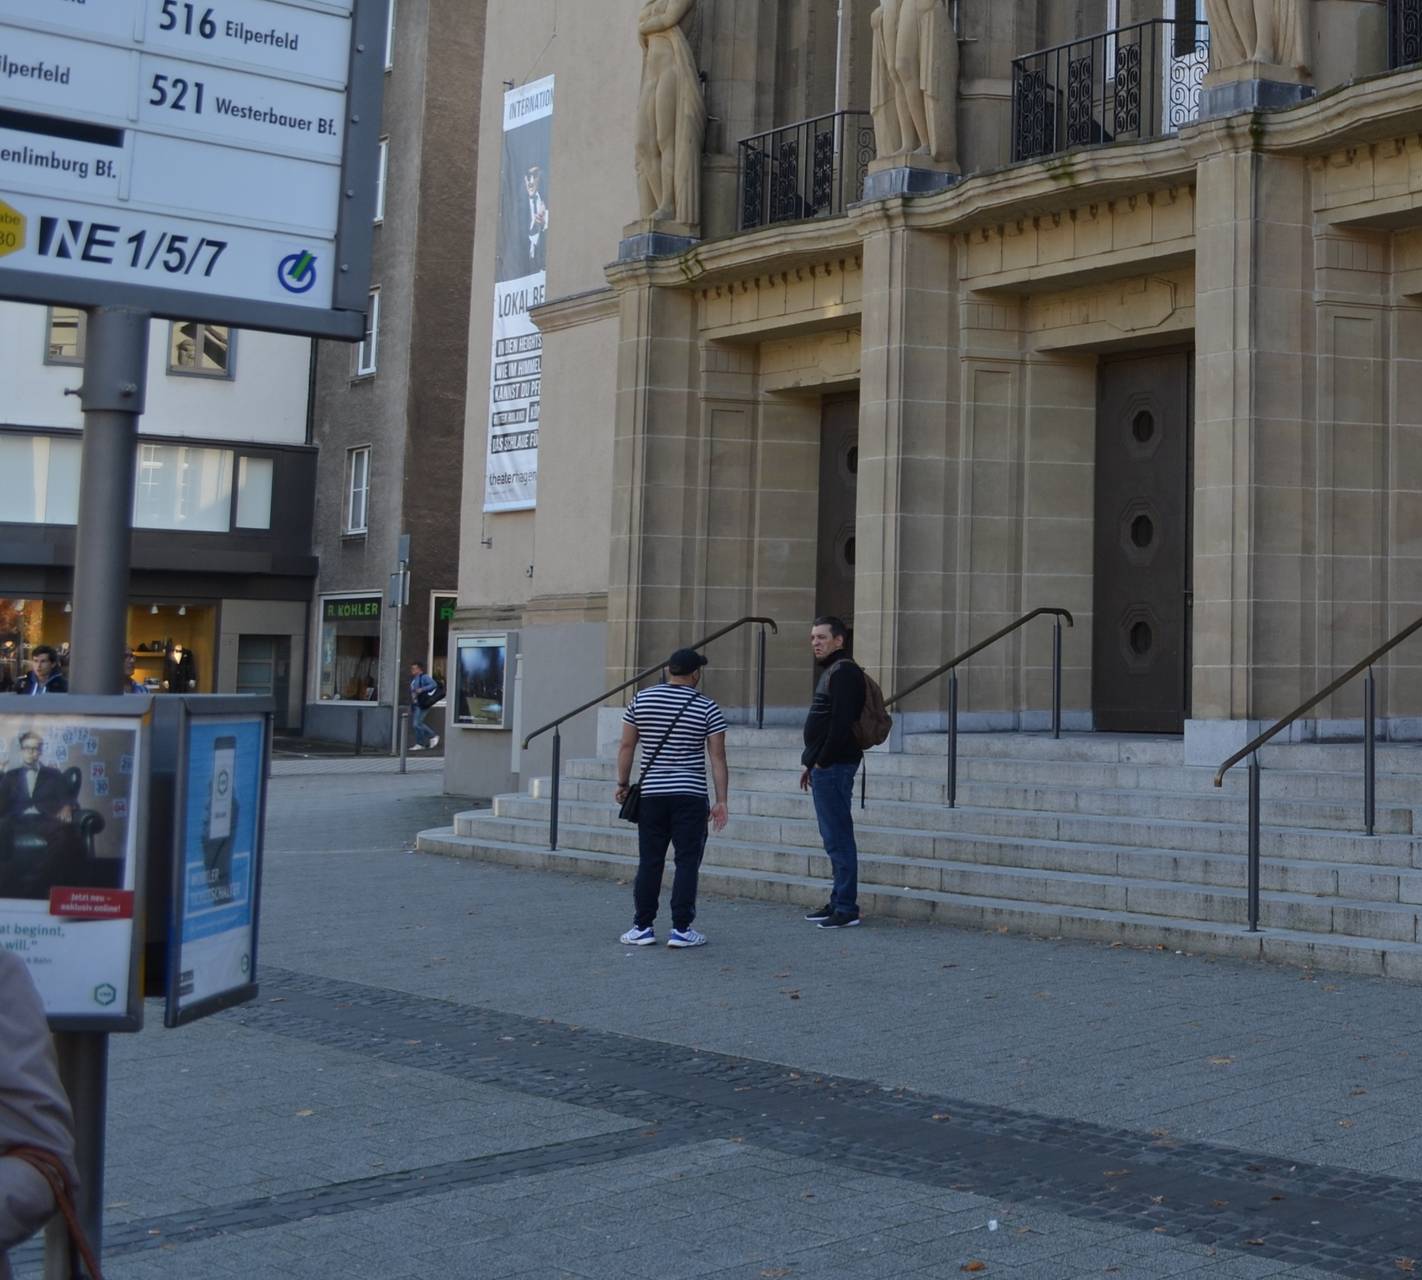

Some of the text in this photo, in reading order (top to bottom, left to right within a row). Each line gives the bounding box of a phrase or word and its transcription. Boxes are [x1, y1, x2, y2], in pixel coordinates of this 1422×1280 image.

[158, 0, 299, 51] 516 Eilperfeld
[149, 73, 337, 136] 521 Westerbauer Bf.
[0, 146, 117, 179] enlimburg Bf.
[127, 229, 228, 277] 1/5/7
